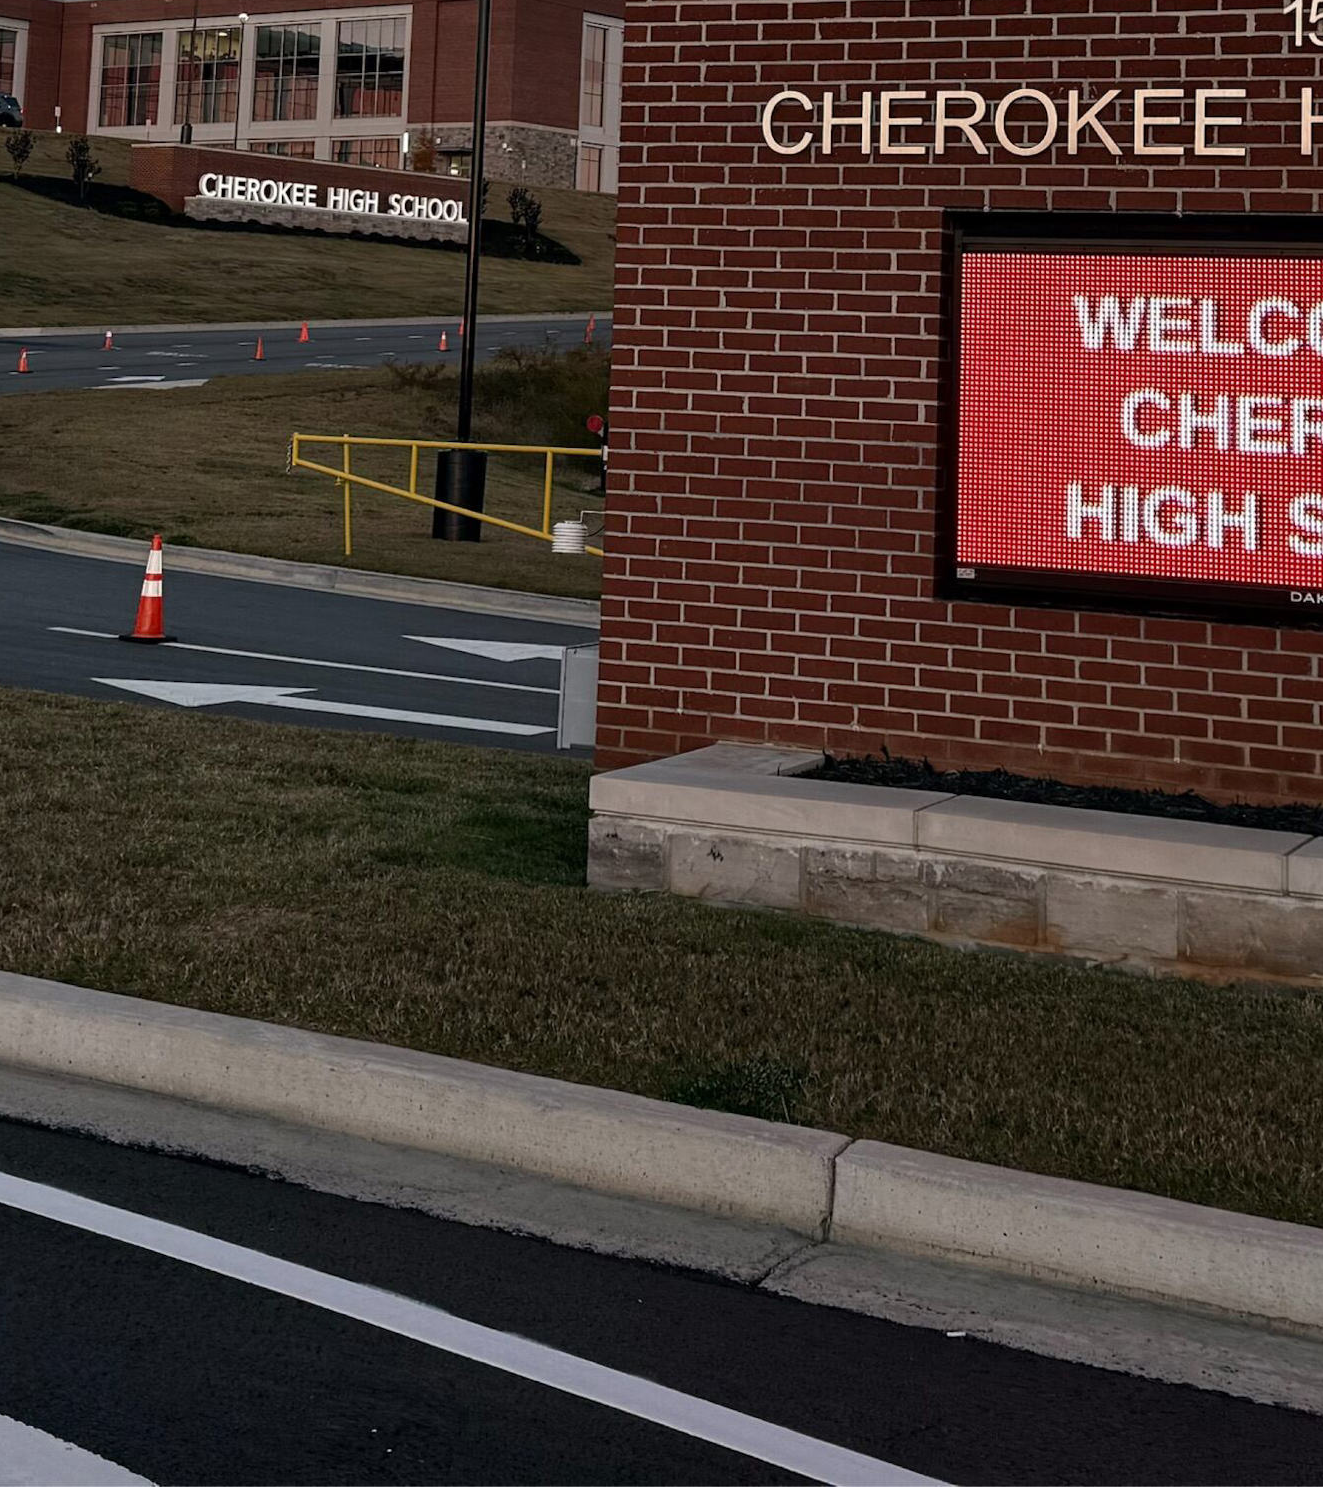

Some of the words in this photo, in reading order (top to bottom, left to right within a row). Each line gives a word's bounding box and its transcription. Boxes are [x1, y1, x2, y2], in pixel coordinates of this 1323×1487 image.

[761, 87, 1247, 157] CHEROKEE
[197, 173, 318, 207] CHEROKEE
[326, 187, 379, 213] HIGH
[387, 194, 469, 222] SCHOOL
[1064, 482, 1262, 552] HIGH
